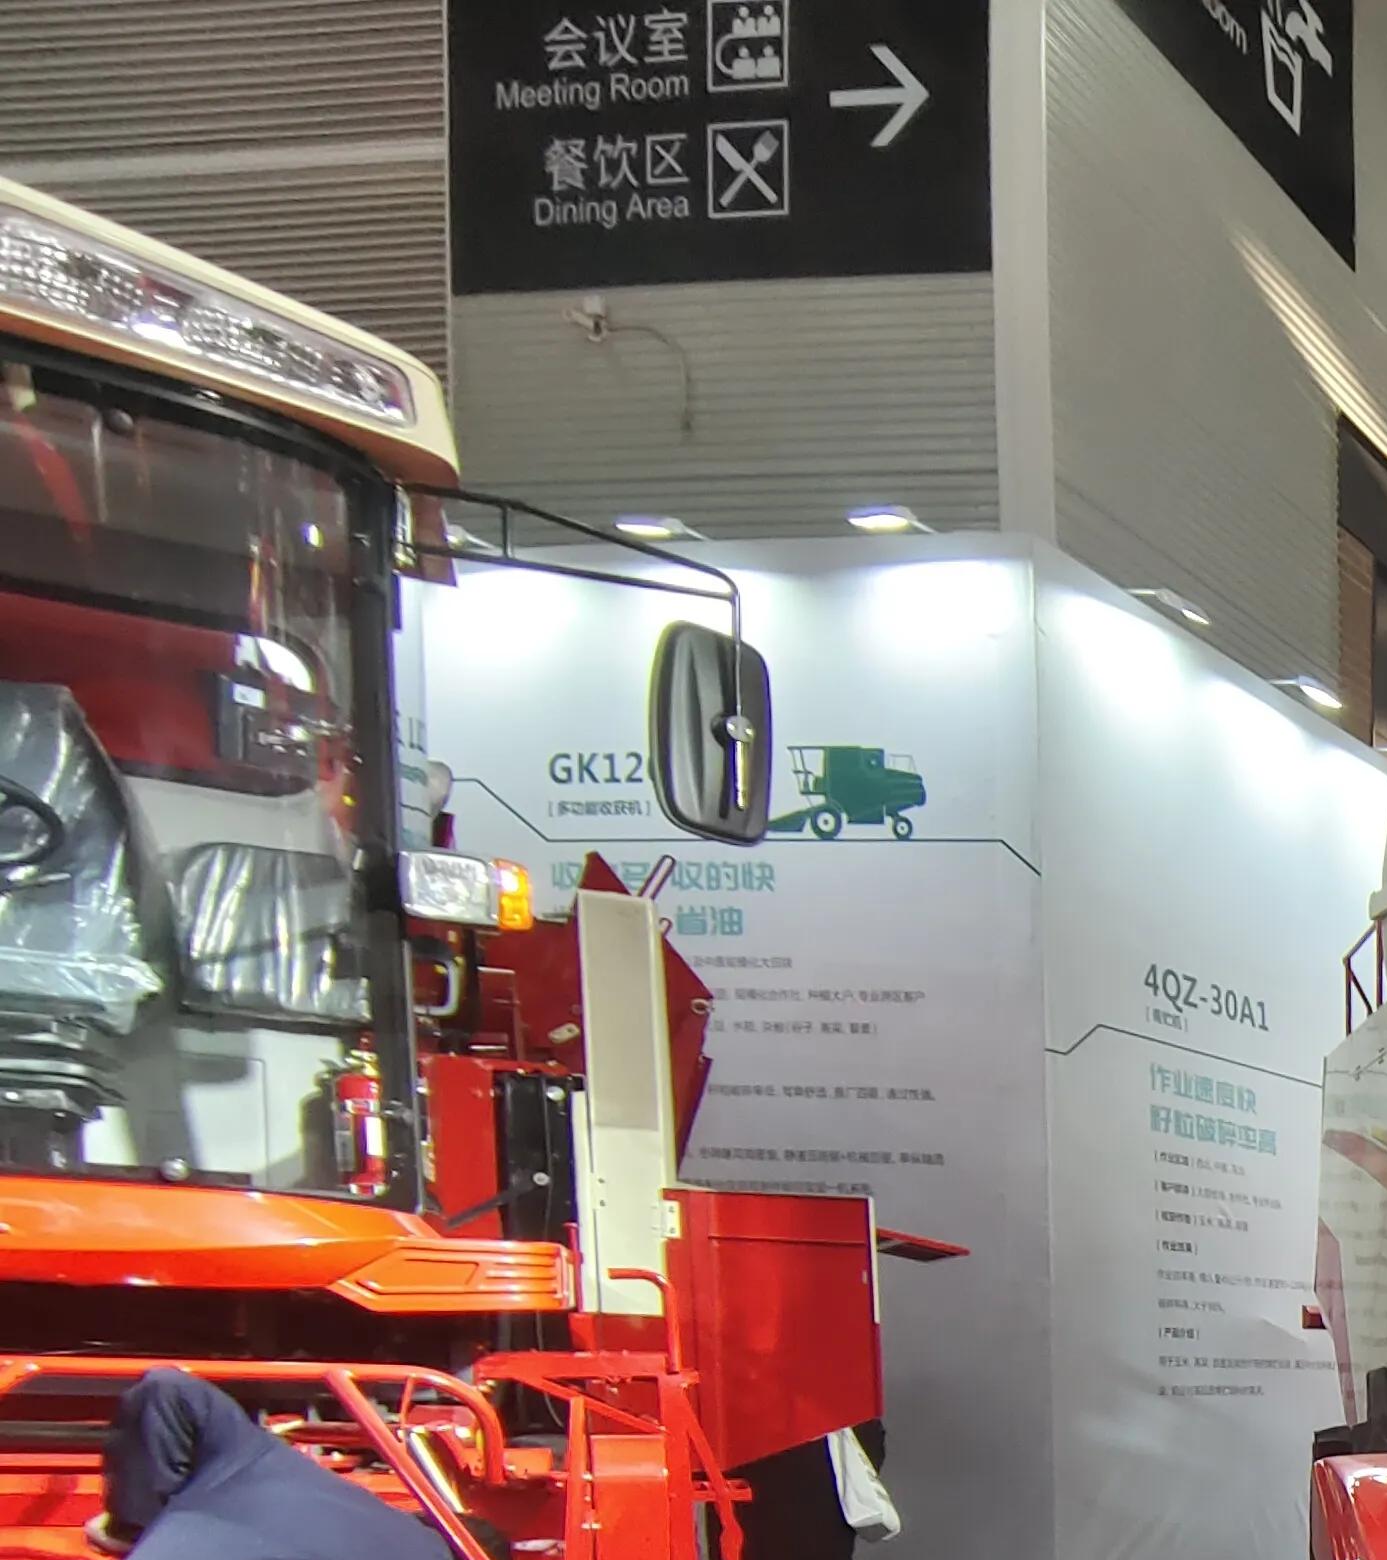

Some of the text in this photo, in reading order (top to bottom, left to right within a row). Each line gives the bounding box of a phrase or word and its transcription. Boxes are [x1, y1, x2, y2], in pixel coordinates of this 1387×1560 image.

[543, 6, 689, 70] 会议室
[495, 73, 690, 110] Meeting Room
[544, 133, 690, 191] 餐饮区
[534, 193, 690, 229] Dining Area
[548, 751, 653, 784] GK12
[1143, 963, 1270, 1032] 4QZ-30A1
